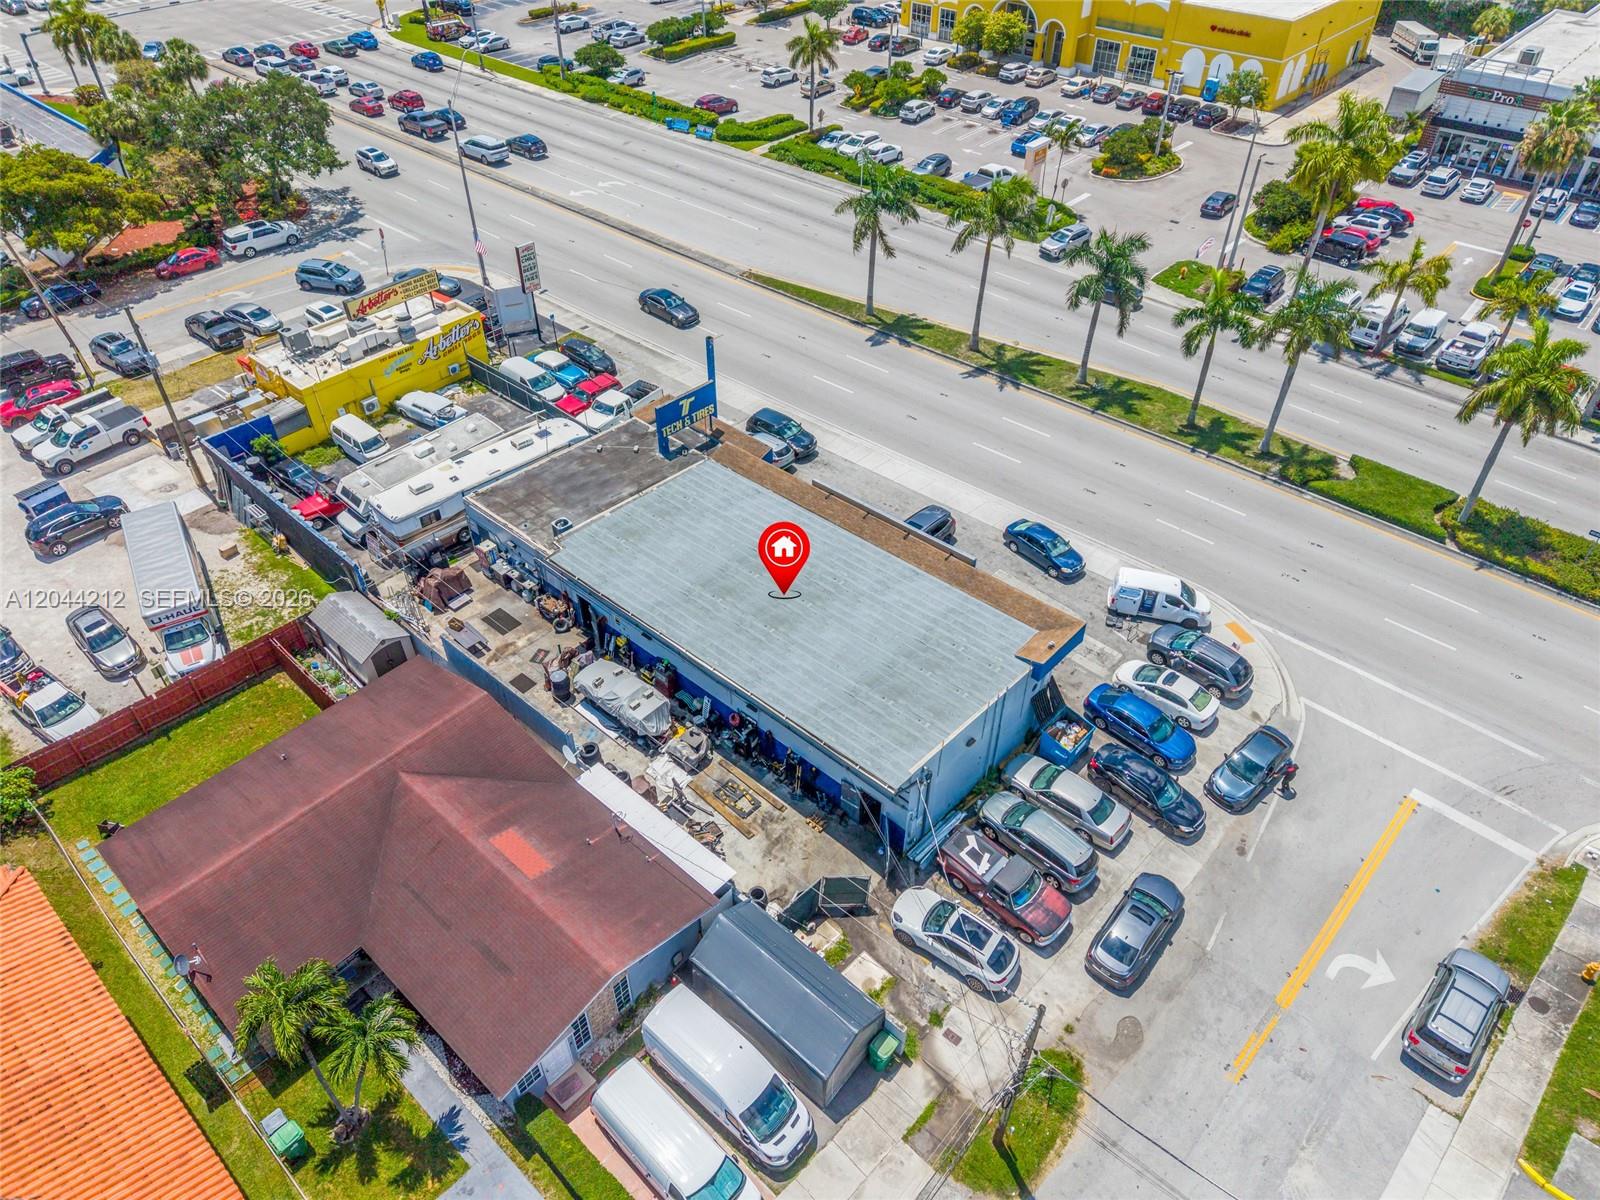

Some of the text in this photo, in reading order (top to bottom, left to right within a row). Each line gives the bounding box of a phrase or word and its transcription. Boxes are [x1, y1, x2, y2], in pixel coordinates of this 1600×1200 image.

[661, 404, 715, 438] TECH & TIRES
[150, 605, 202, 625] U-HAUL
